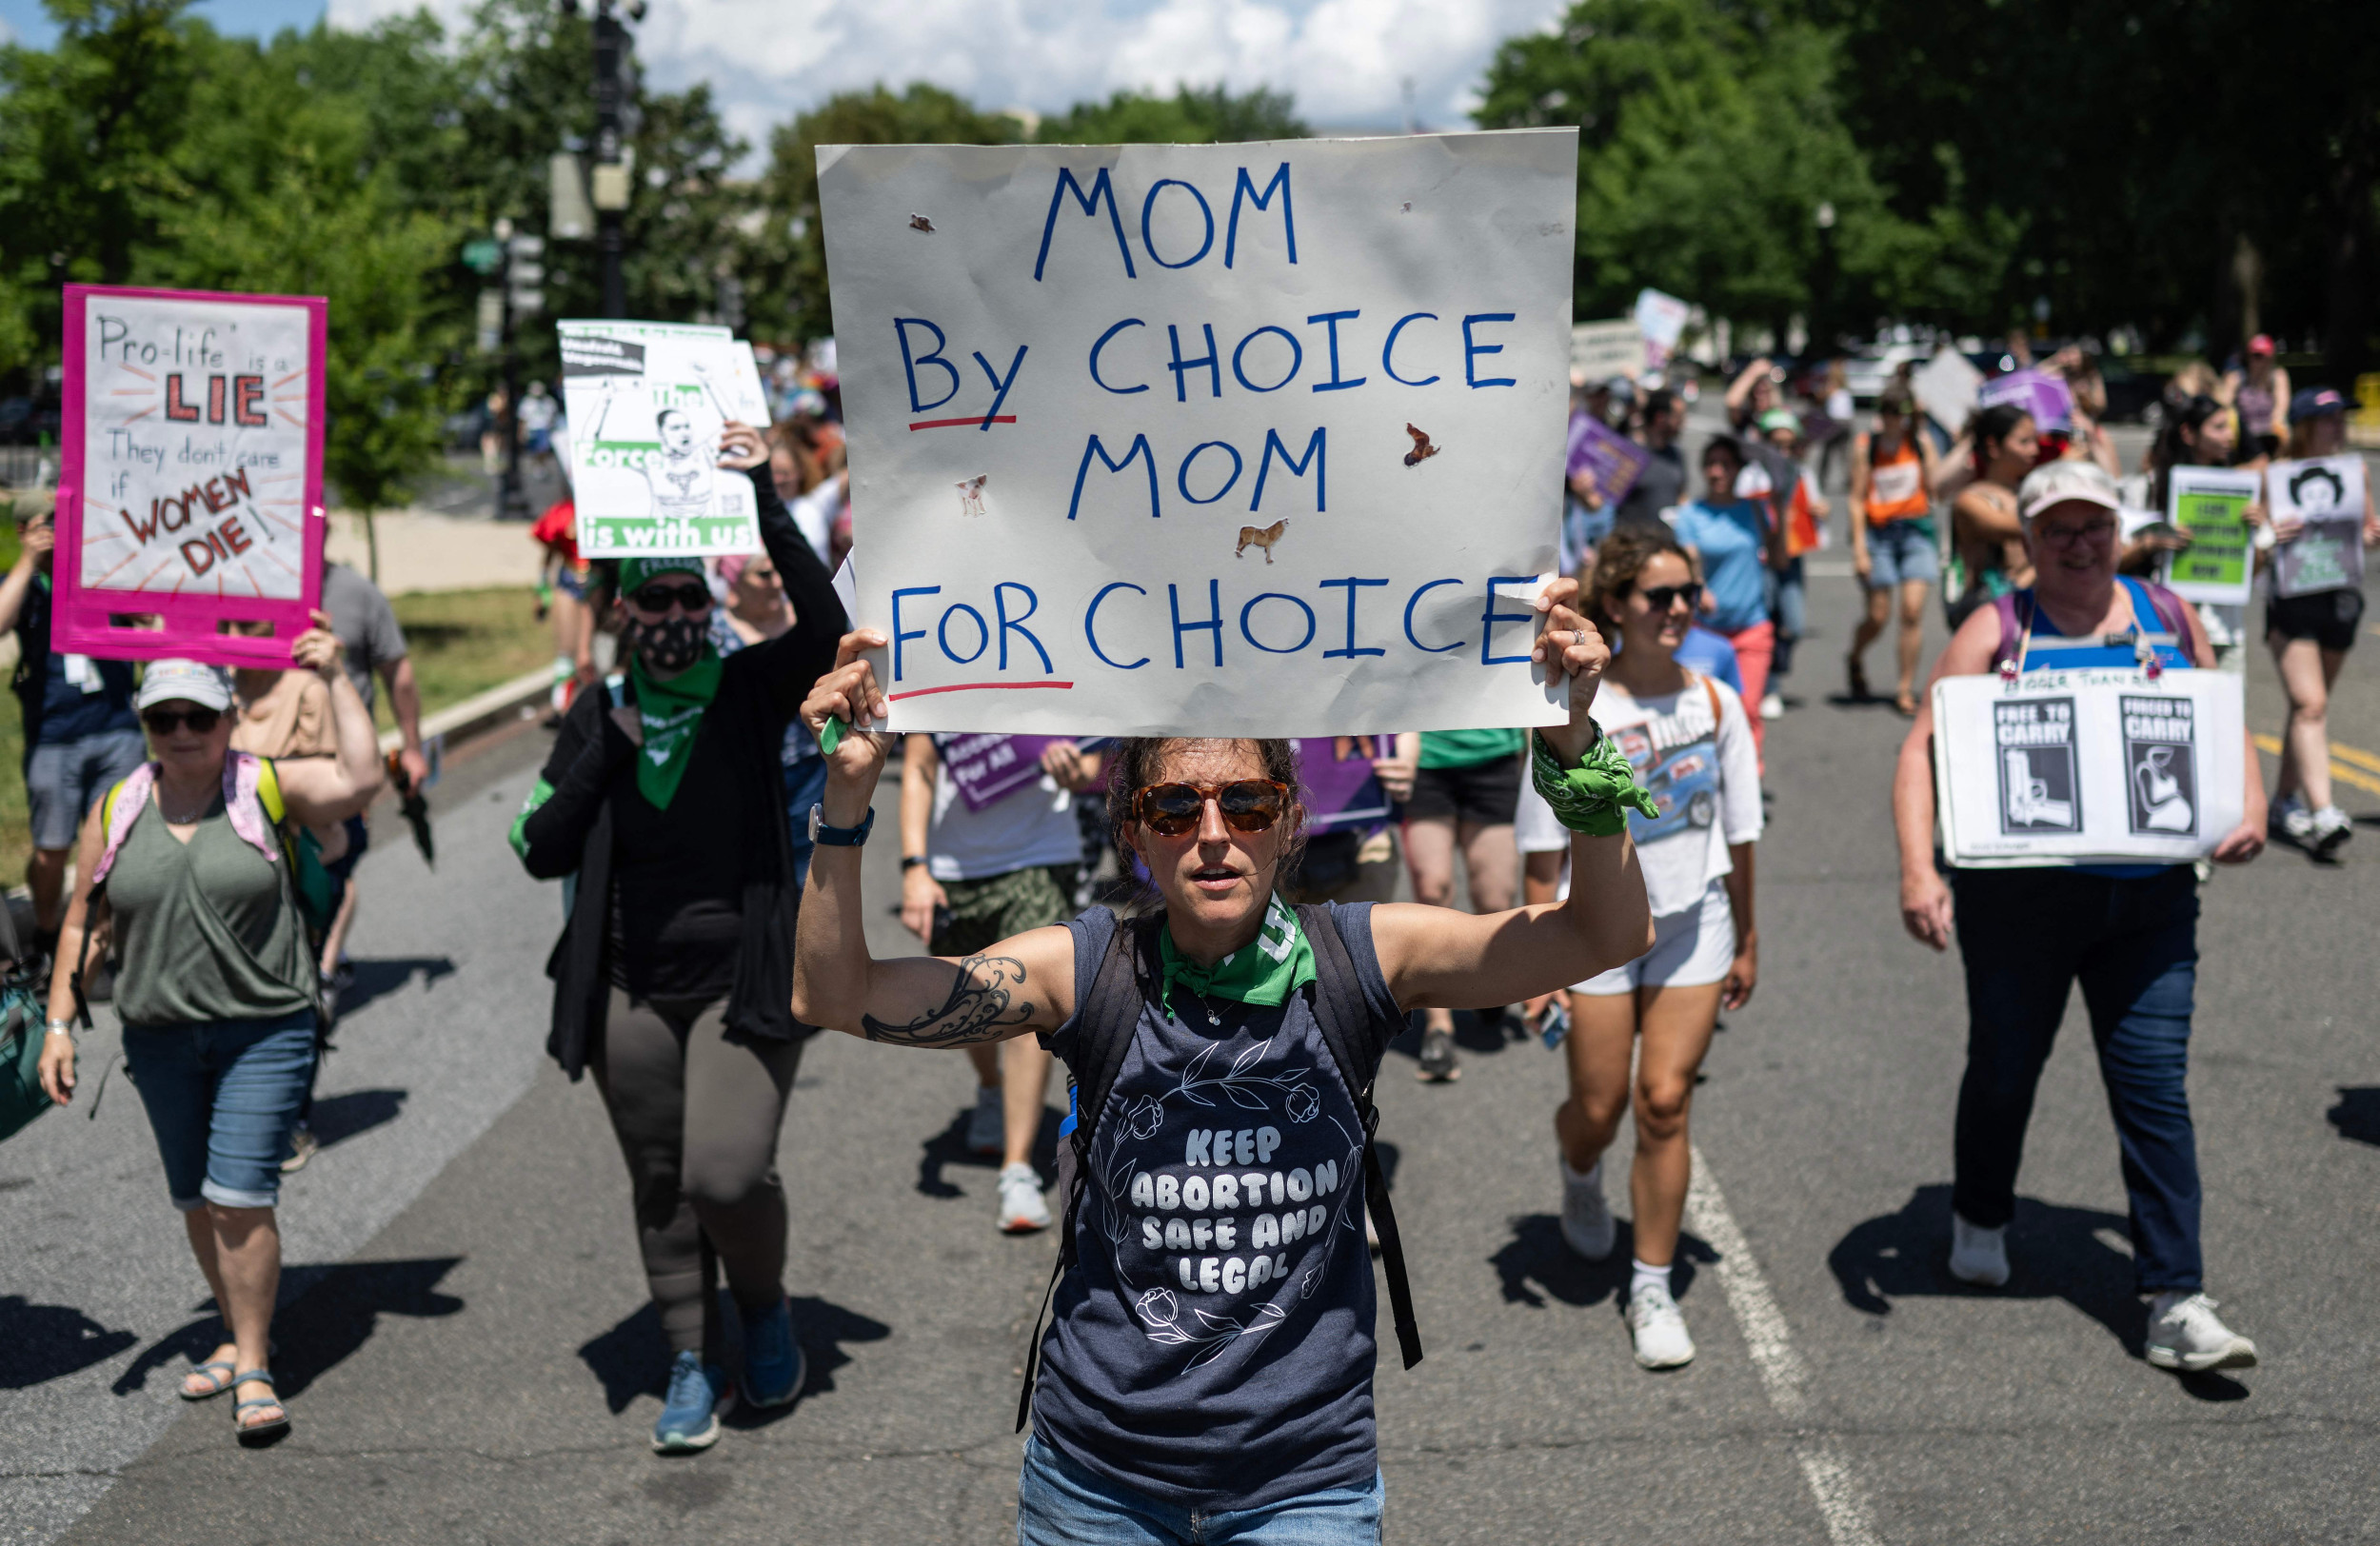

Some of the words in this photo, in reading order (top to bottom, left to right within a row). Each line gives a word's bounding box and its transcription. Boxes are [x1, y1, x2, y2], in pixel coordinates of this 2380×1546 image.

[1034, 162, 1299, 283] MOM
[248, 349, 265, 372] is
[274, 356, 289, 372] a
[1088, 309, 1517, 403] CHOICE
[654, 385, 704, 407] The
[106, 427, 166, 473] They
[235, 451, 281, 468] care
[578, 443, 664, 468] Force
[110, 469, 130, 499] if
[1067, 427, 1327, 521] MOM
[119, 466, 252, 545] WOMEN
[587, 518, 614, 546] is
[623, 517, 701, 546] with
[711, 525, 752, 546] us
[891, 582, 1054, 683] FOR
[1084, 575, 1539, 670] CHOICE
[1997, 704, 2040, 724] FREE
[2045, 703, 2072, 723] TO
[2124, 698, 2173, 718] FORCED
[2174, 700, 2192, 718] TO
[1997, 722, 2073, 745] CARRY
[2125, 717, 2192, 743] CARRY
[1185, 1125, 1281, 1167] KEEP
[1131, 1160, 1339, 1211] ABORTION
[1141, 1216, 1236, 1251] SAFE
[1252, 1204, 1327, 1249] AND
[1180, 1252, 1289, 1295] LEGAL
